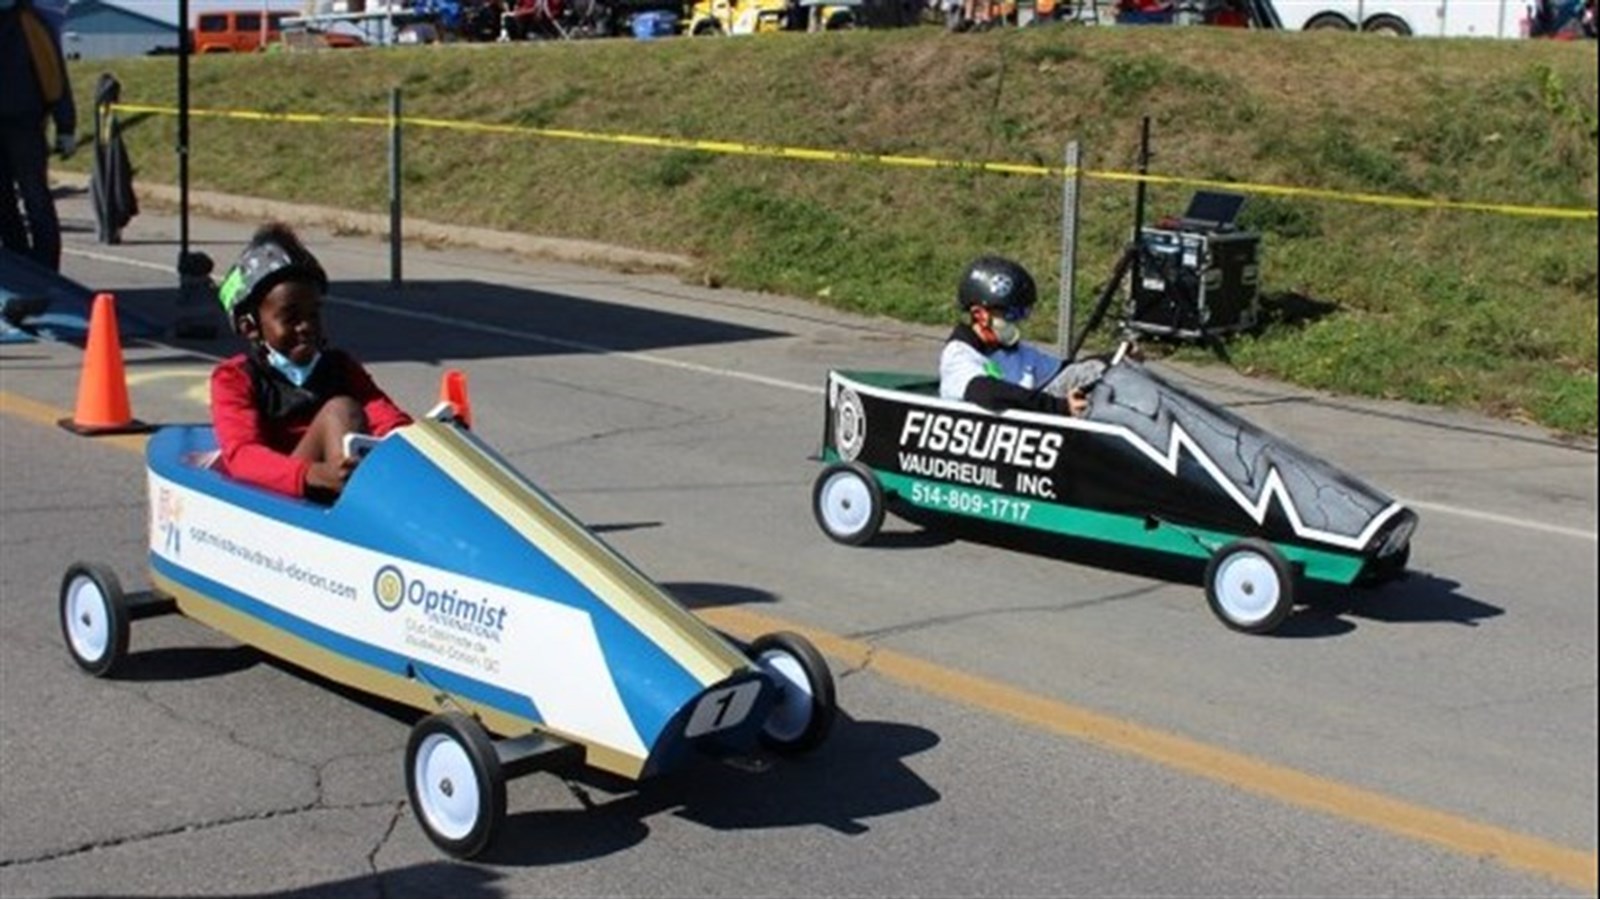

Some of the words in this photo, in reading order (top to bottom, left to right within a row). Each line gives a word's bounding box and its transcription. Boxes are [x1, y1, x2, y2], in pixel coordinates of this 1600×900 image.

[900, 411, 1063, 470] FISSURES
[899, 452, 1003, 488] VAUDREUIL
[1016, 473, 1057, 499] INC.
[912, 483, 1031, 521] 514-809-1717
[408, 580, 507, 631] Optimist
[712, 690, 737, 726] 1
